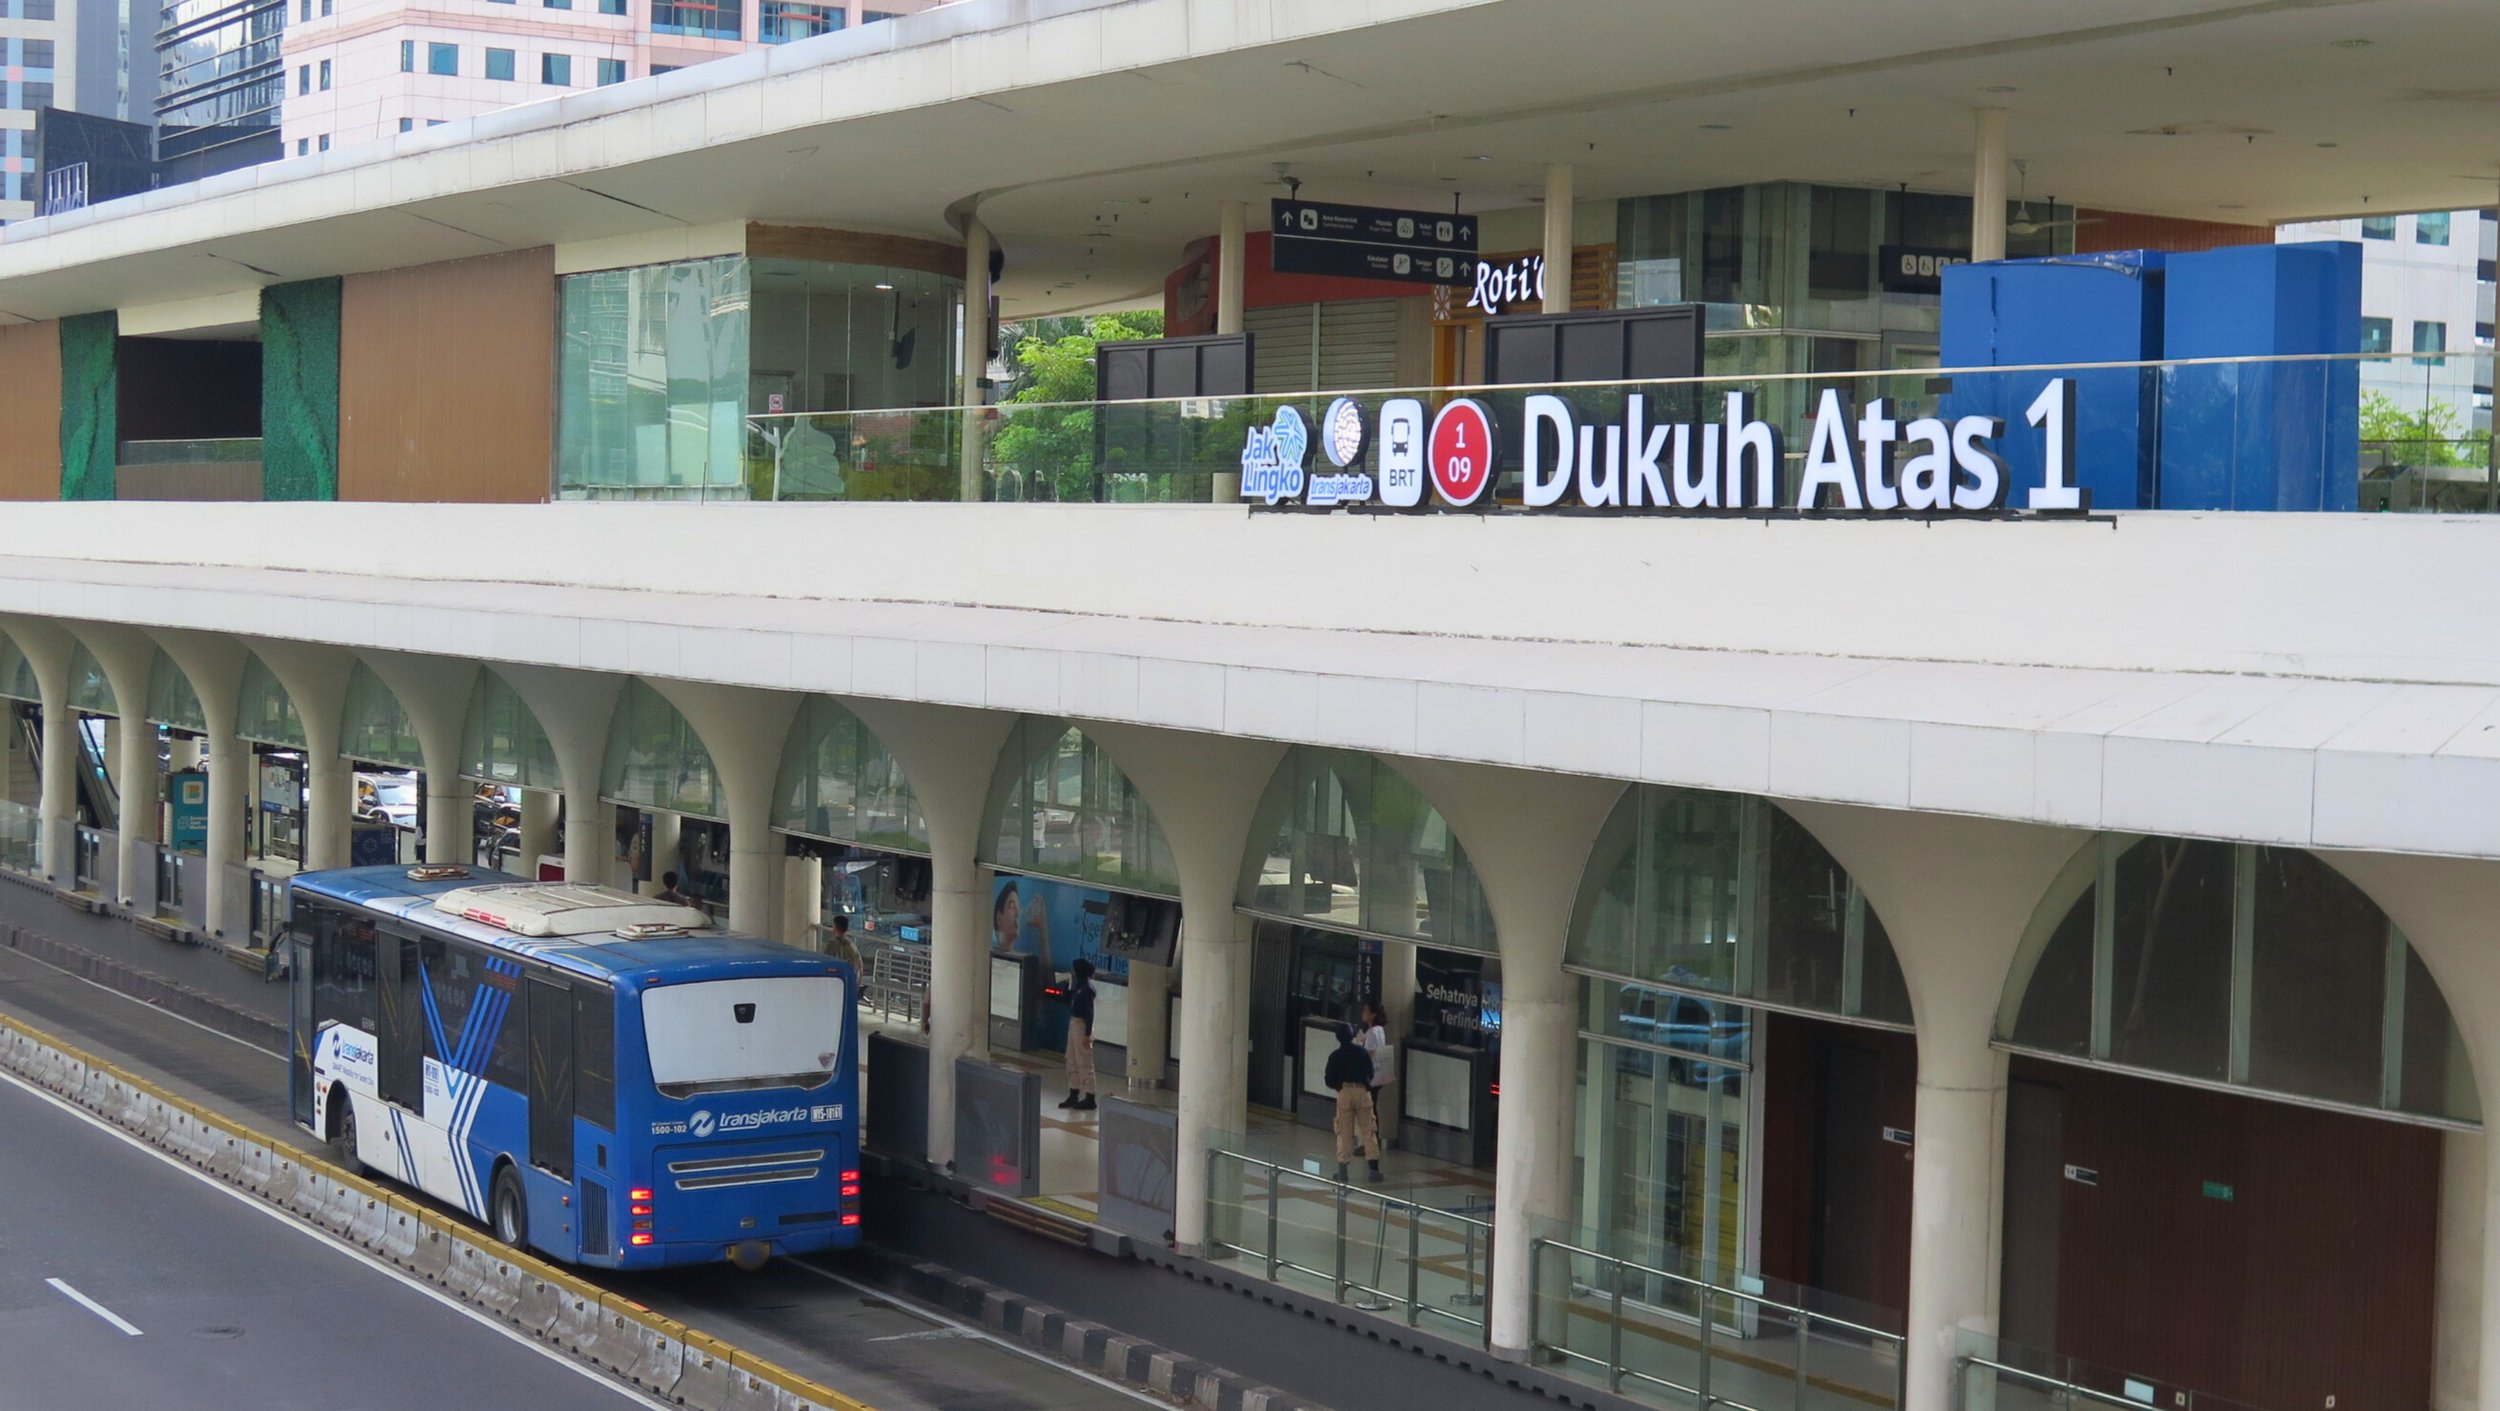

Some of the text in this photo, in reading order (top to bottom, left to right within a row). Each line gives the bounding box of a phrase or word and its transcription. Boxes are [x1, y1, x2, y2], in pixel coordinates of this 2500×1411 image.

[1244, 430, 1279, 461] Jak
[1455, 422, 1466, 449] 1
[1523, 377, 2084, 511] Dukuh Atas 1
[1243, 462, 1301, 500] Lingko
[1389, 469, 1415, 487] BRT
[1448, 456, 1472, 484] 09
[1310, 475, 1370, 500] transjakarta
[1364, 955, 1372, 994] ATAS
[1426, 983, 1478, 1009] Sehatnya
[651, 1124, 688, 1135] 1500-102
[718, 1106, 808, 1132] transjakarta
